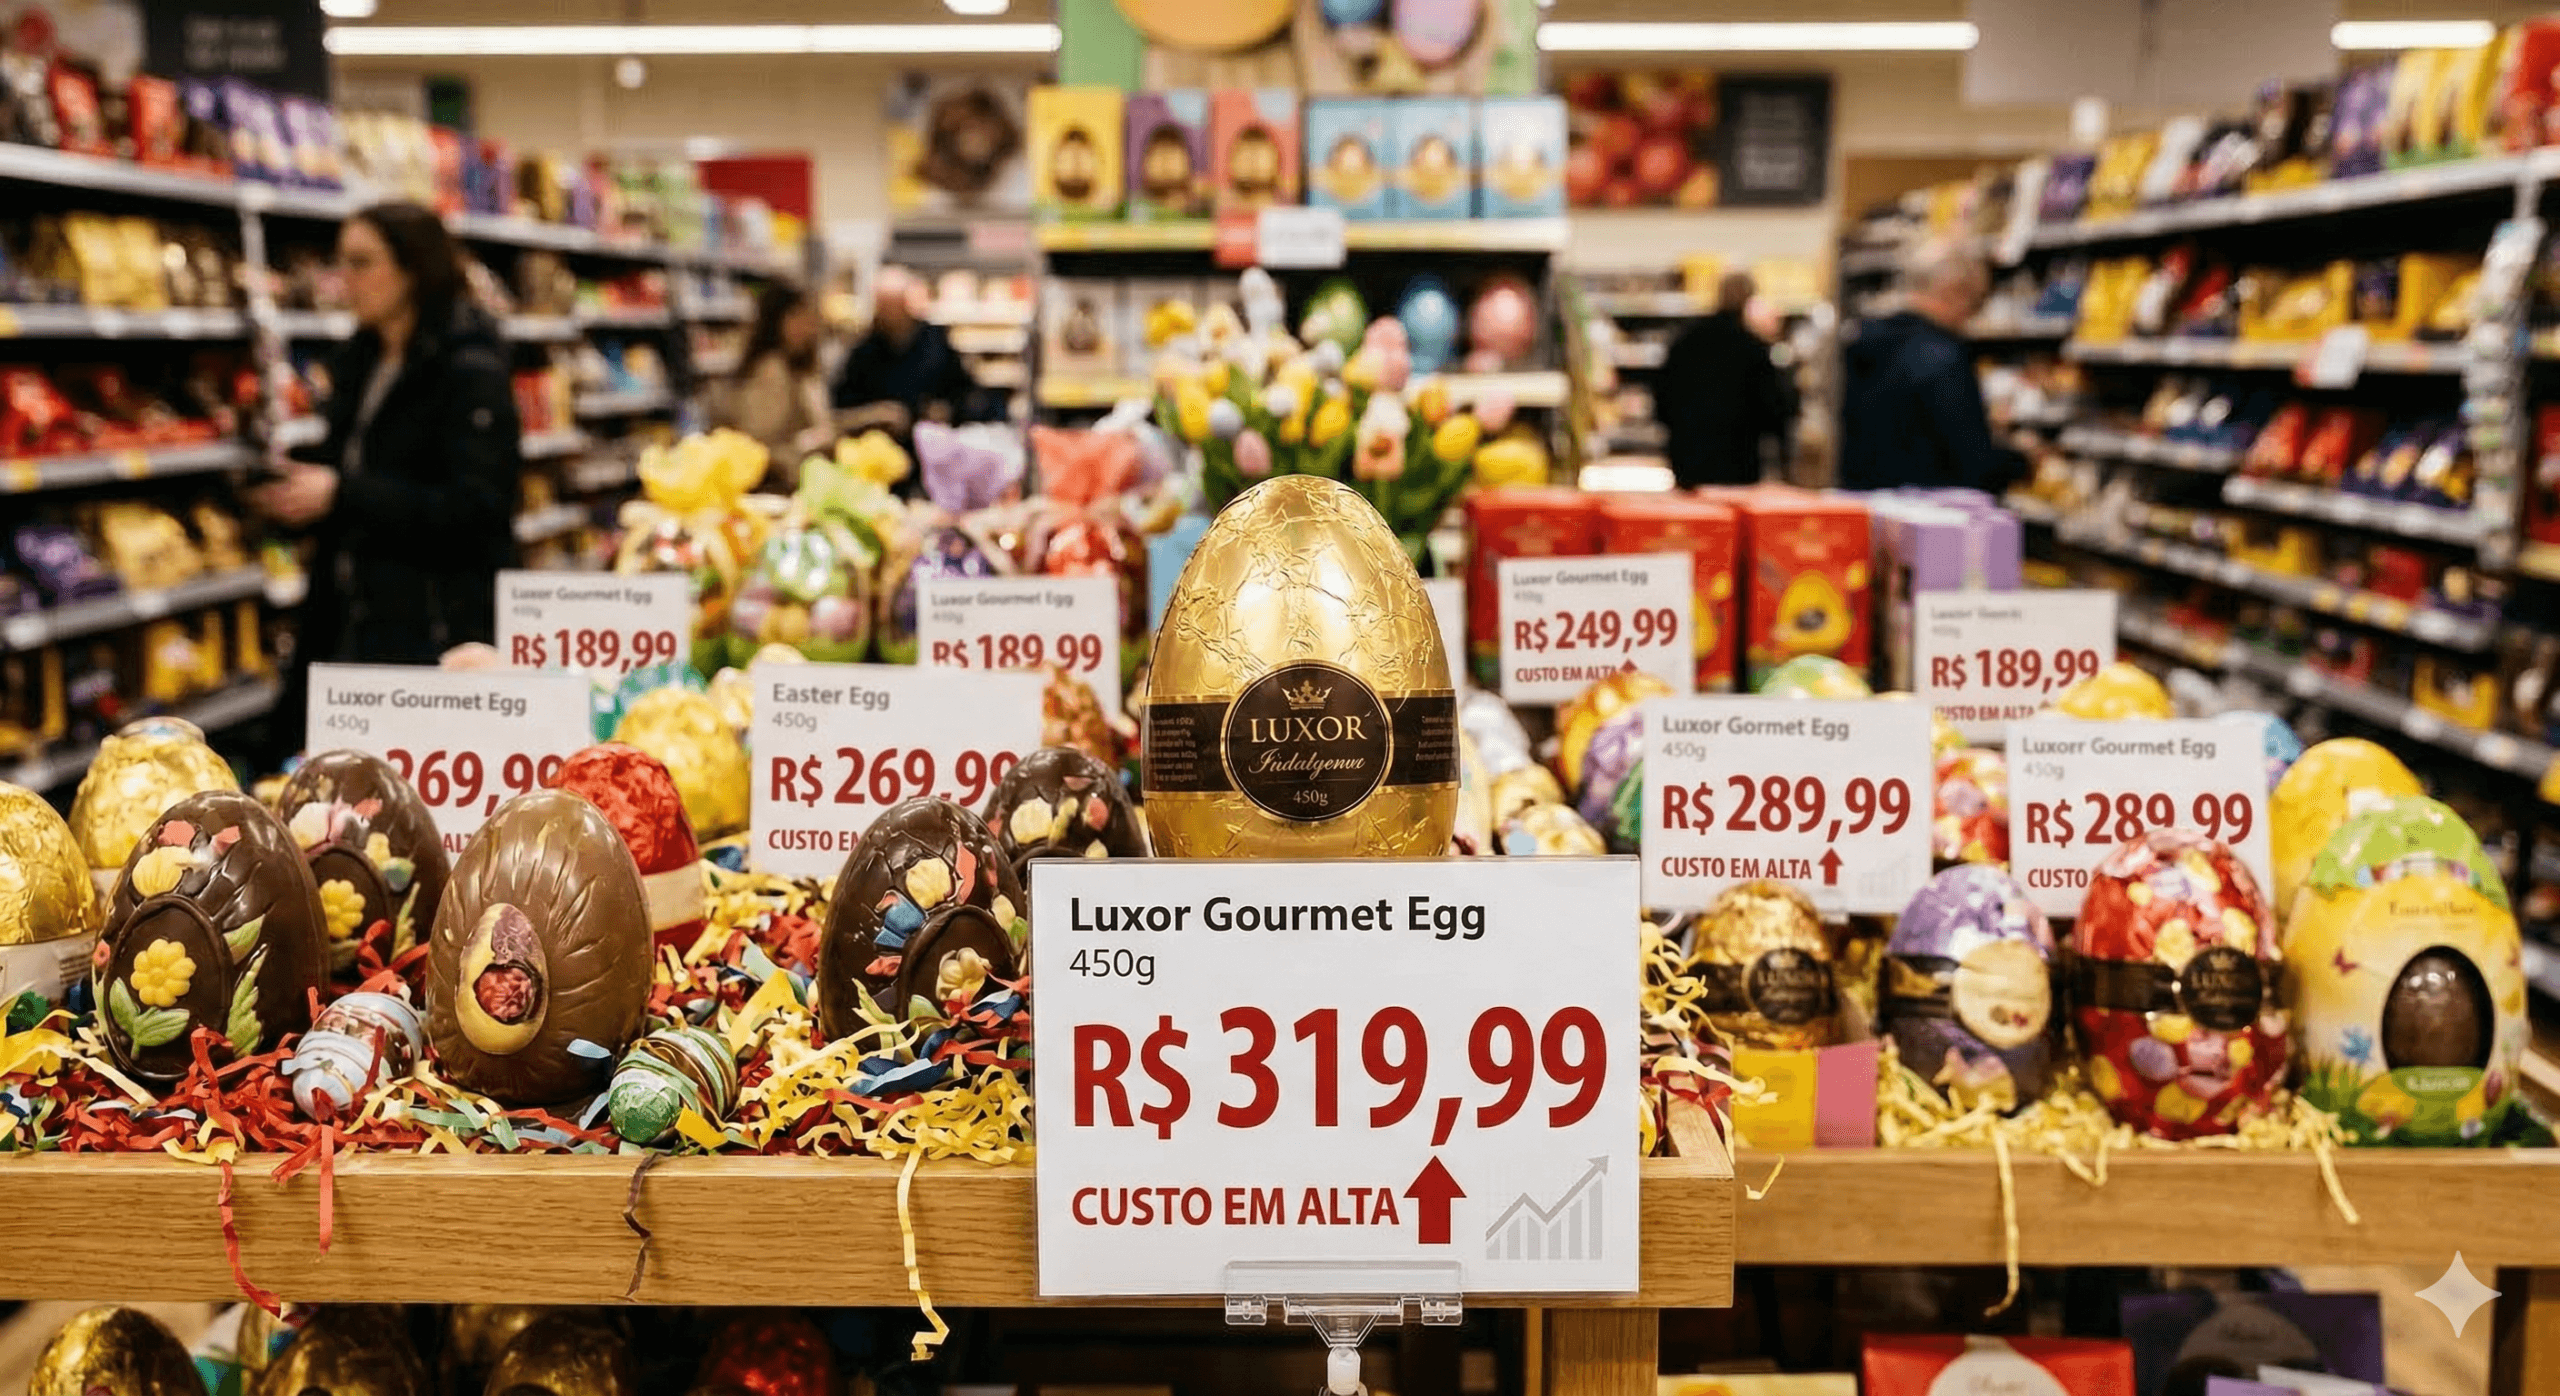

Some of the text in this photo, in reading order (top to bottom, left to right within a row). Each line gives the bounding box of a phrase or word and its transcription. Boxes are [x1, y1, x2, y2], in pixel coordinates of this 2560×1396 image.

[1556, 570, 1618, 585] Gourmet
[1622, 569, 1649, 586] Egg
[624, 587, 653, 605] Egg
[1514, 608, 1678, 654] R$ 249,99
[512, 628, 678, 674] R$ 189,99
[932, 633, 1103, 672] R$ 18999
[1515, 667, 1559, 682] CUSTO
[1562, 666, 1582, 681] EM
[1931, 648, 2099, 694] R$ 189,99
[327, 687, 527, 717] Luxor Gourmet Egg
[773, 683, 890, 711] Easter Egg
[326, 714, 369, 734] 450g
[772, 711, 817, 732] 450g
[1979, 705, 2000, 721] EM
[1250, 715, 1367, 743] LUXOR
[1663, 715, 1849, 741] Luxor Gormet Egg
[1662, 742, 1706, 762] 450g
[2091, 737, 2175, 756] Gourmet
[2181, 738, 2216, 760] Egg
[771, 754, 823, 807] R$
[1293, 789, 1329, 807] 450g
[1663, 775, 1911, 843] R$ 289,99
[2026, 793, 2253, 849] R$ 28999
[768, 829, 833, 850] CUSTO
[1661, 857, 1812, 880] CUSTO EM ALTA
[2028, 868, 2088, 888] CUSTO
[1070, 895, 1486, 941] Luxor Gourmet Egg
[1069, 948, 1157, 985] 450g
[1074, 1005, 1608, 1147] R$ 319,99
[1072, 1186, 1400, 1226] CUSTO EM ALTA
